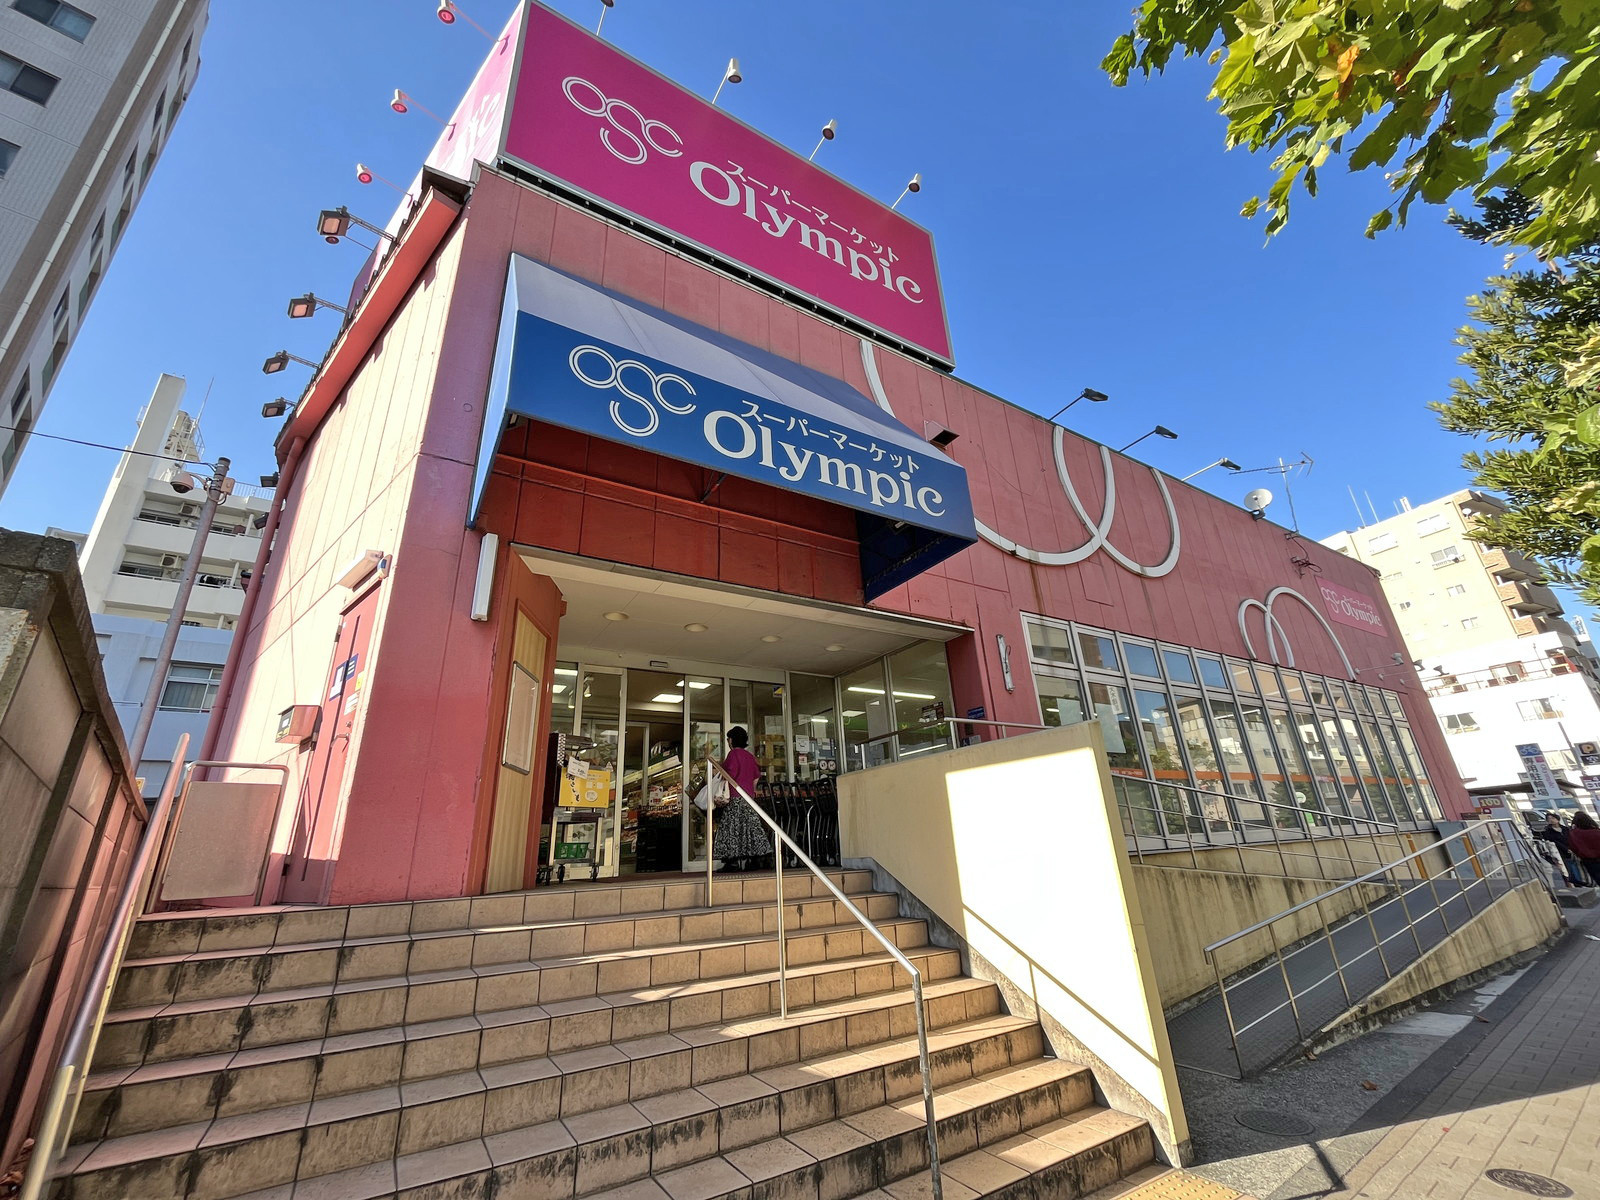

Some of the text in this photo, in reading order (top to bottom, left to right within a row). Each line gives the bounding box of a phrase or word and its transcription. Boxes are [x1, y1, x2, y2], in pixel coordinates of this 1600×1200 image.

[690, 161, 924, 304] Olympic
[727, 159, 899, 262] スーパーマーケット
[703, 409, 946, 517] Olympic
[742, 399, 920, 474] スーパーマーケット
[1340, 600, 1383, 627] Olympic
